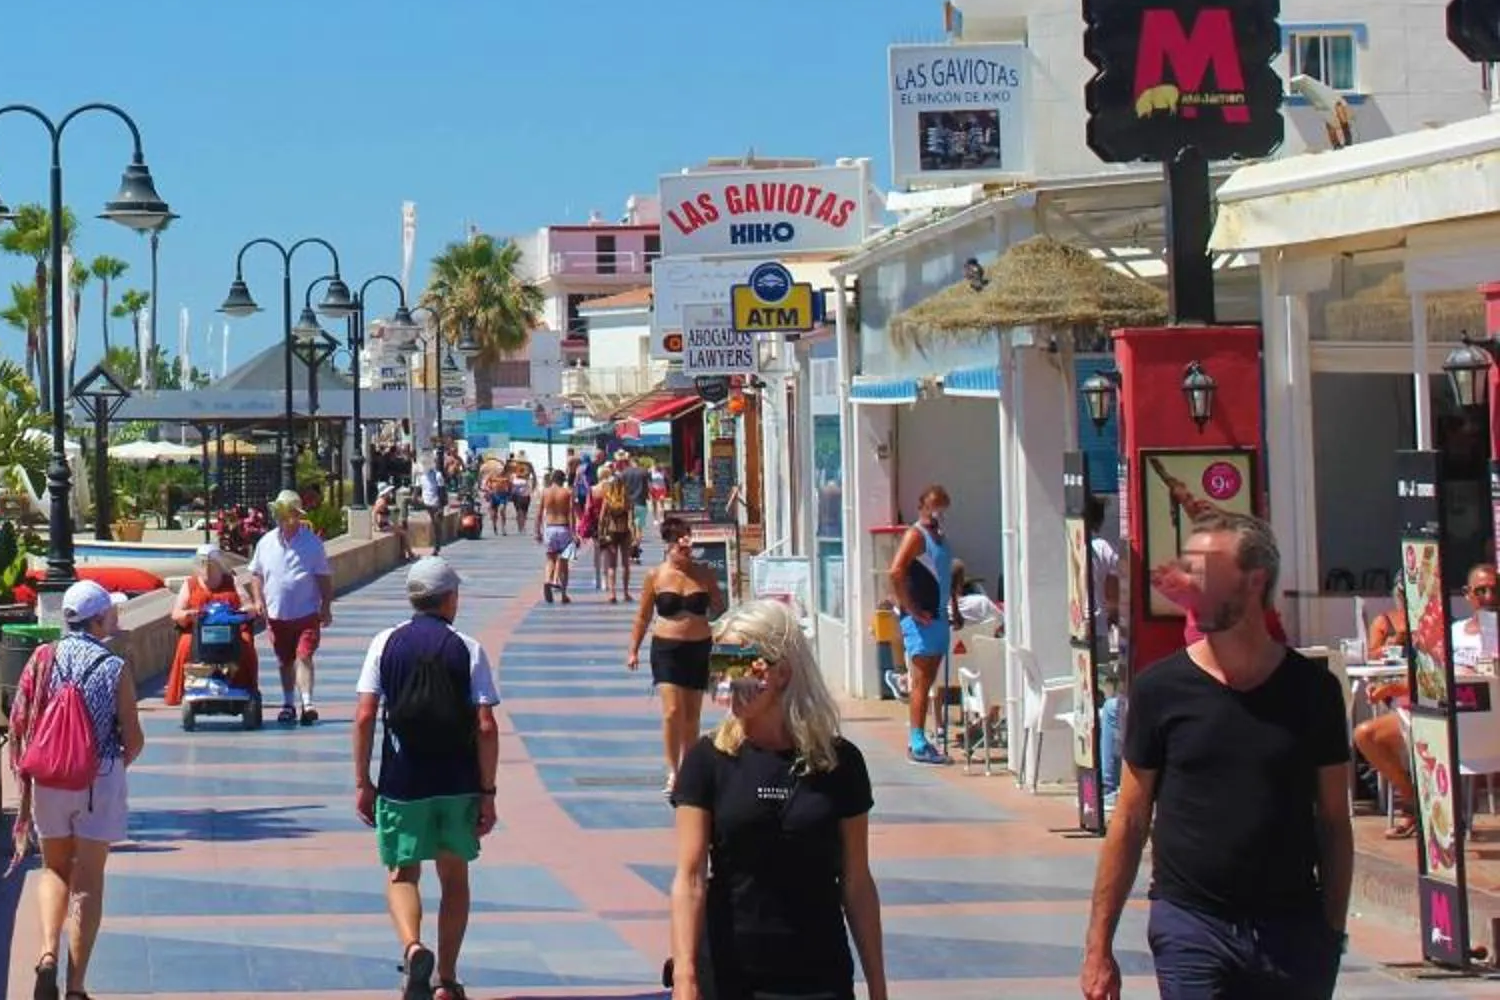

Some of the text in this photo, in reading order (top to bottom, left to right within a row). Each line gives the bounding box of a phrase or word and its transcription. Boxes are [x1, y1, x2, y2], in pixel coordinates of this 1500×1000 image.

[895, 57, 1019, 91] LAS GAVIOTAS
[901, 93, 913, 105] EL
[964, 92, 979, 102] DE
[984, 90, 1011, 102] KIKO
[667, 182, 857, 236] LAS GAVIOTAS
[747, 307, 799, 327] ATM
[689, 349, 753, 368] LAWYERS
